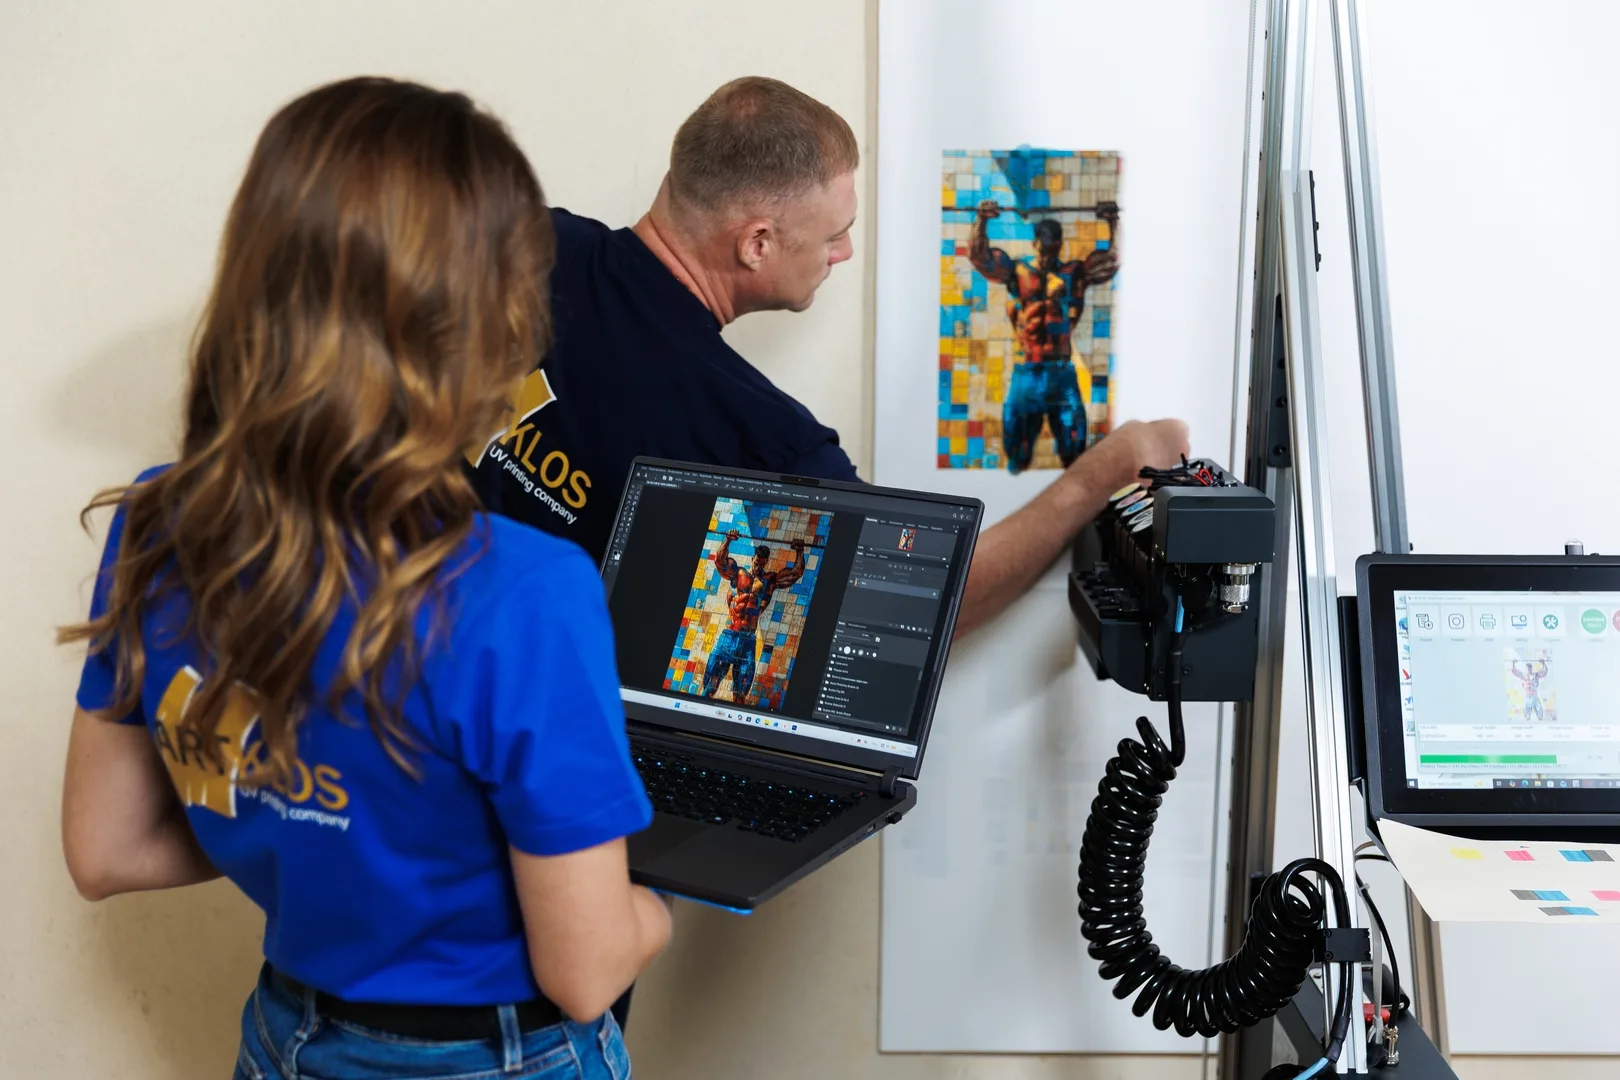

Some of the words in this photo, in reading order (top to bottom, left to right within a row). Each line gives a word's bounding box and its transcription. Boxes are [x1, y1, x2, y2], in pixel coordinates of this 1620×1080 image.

[489, 445, 509, 463] UV
[503, 459, 534, 493] printing
[534, 487, 578, 525] company
[499, 421, 592, 509] KLOS
[289, 807, 350, 832] company
